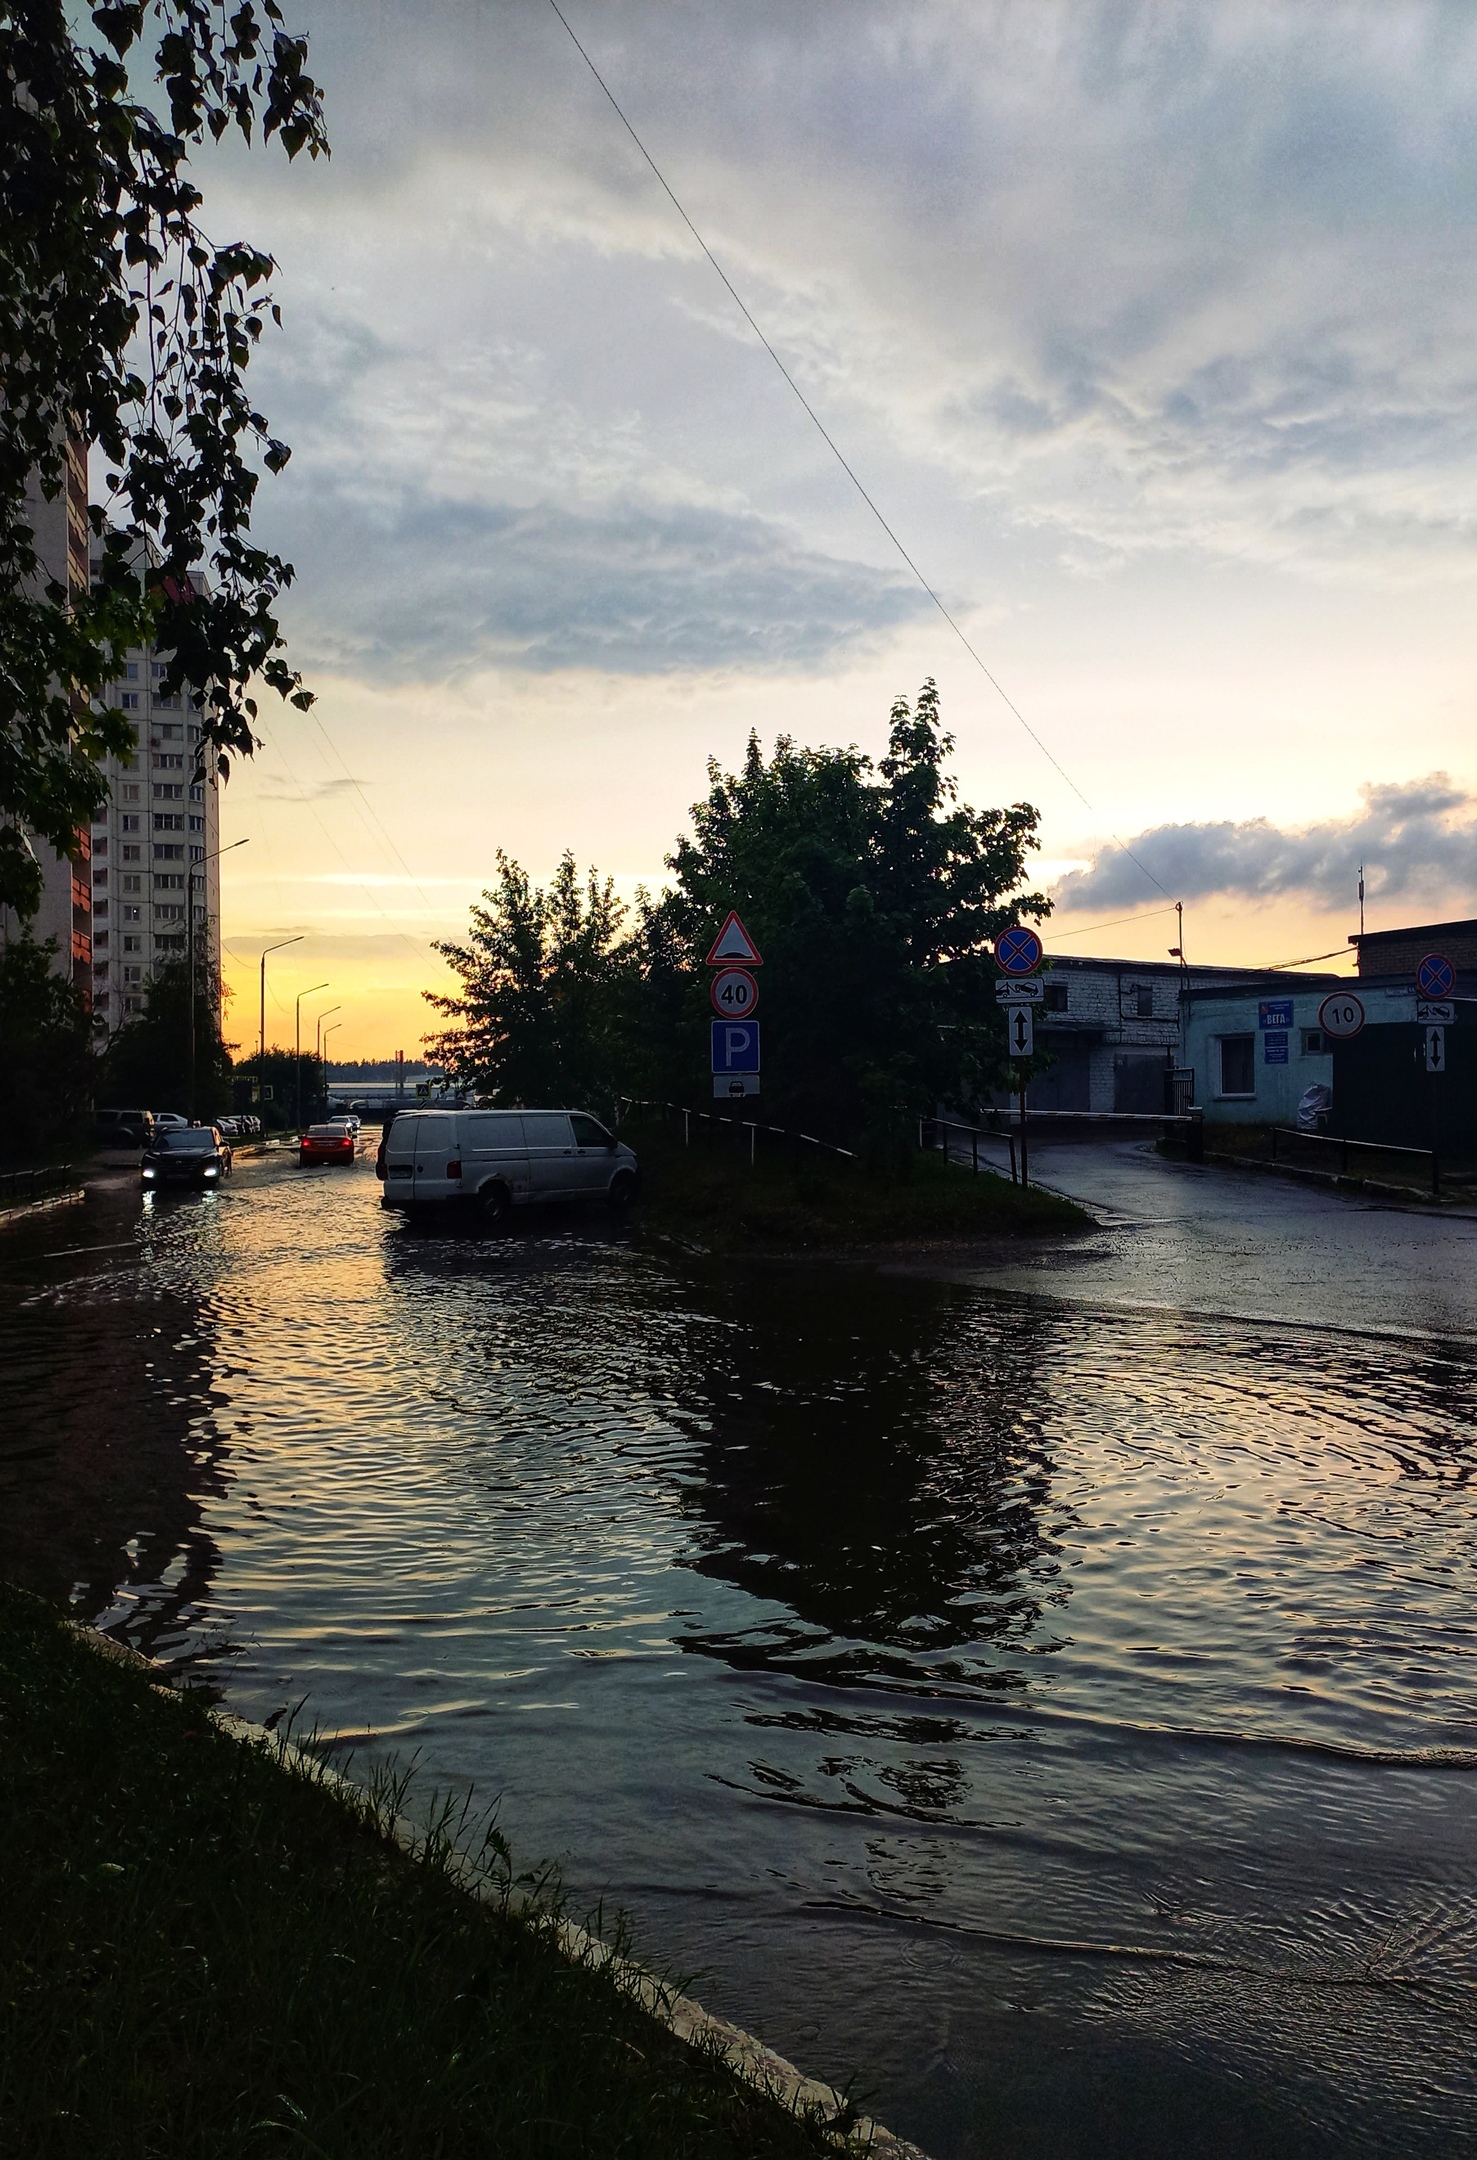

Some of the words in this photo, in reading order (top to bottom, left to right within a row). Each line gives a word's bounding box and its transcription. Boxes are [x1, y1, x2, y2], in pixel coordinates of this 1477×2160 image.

[721, 984, 748, 1004] 40
[1332, 1007, 1354, 1024] 10
[725, 1027, 751, 1067] P
